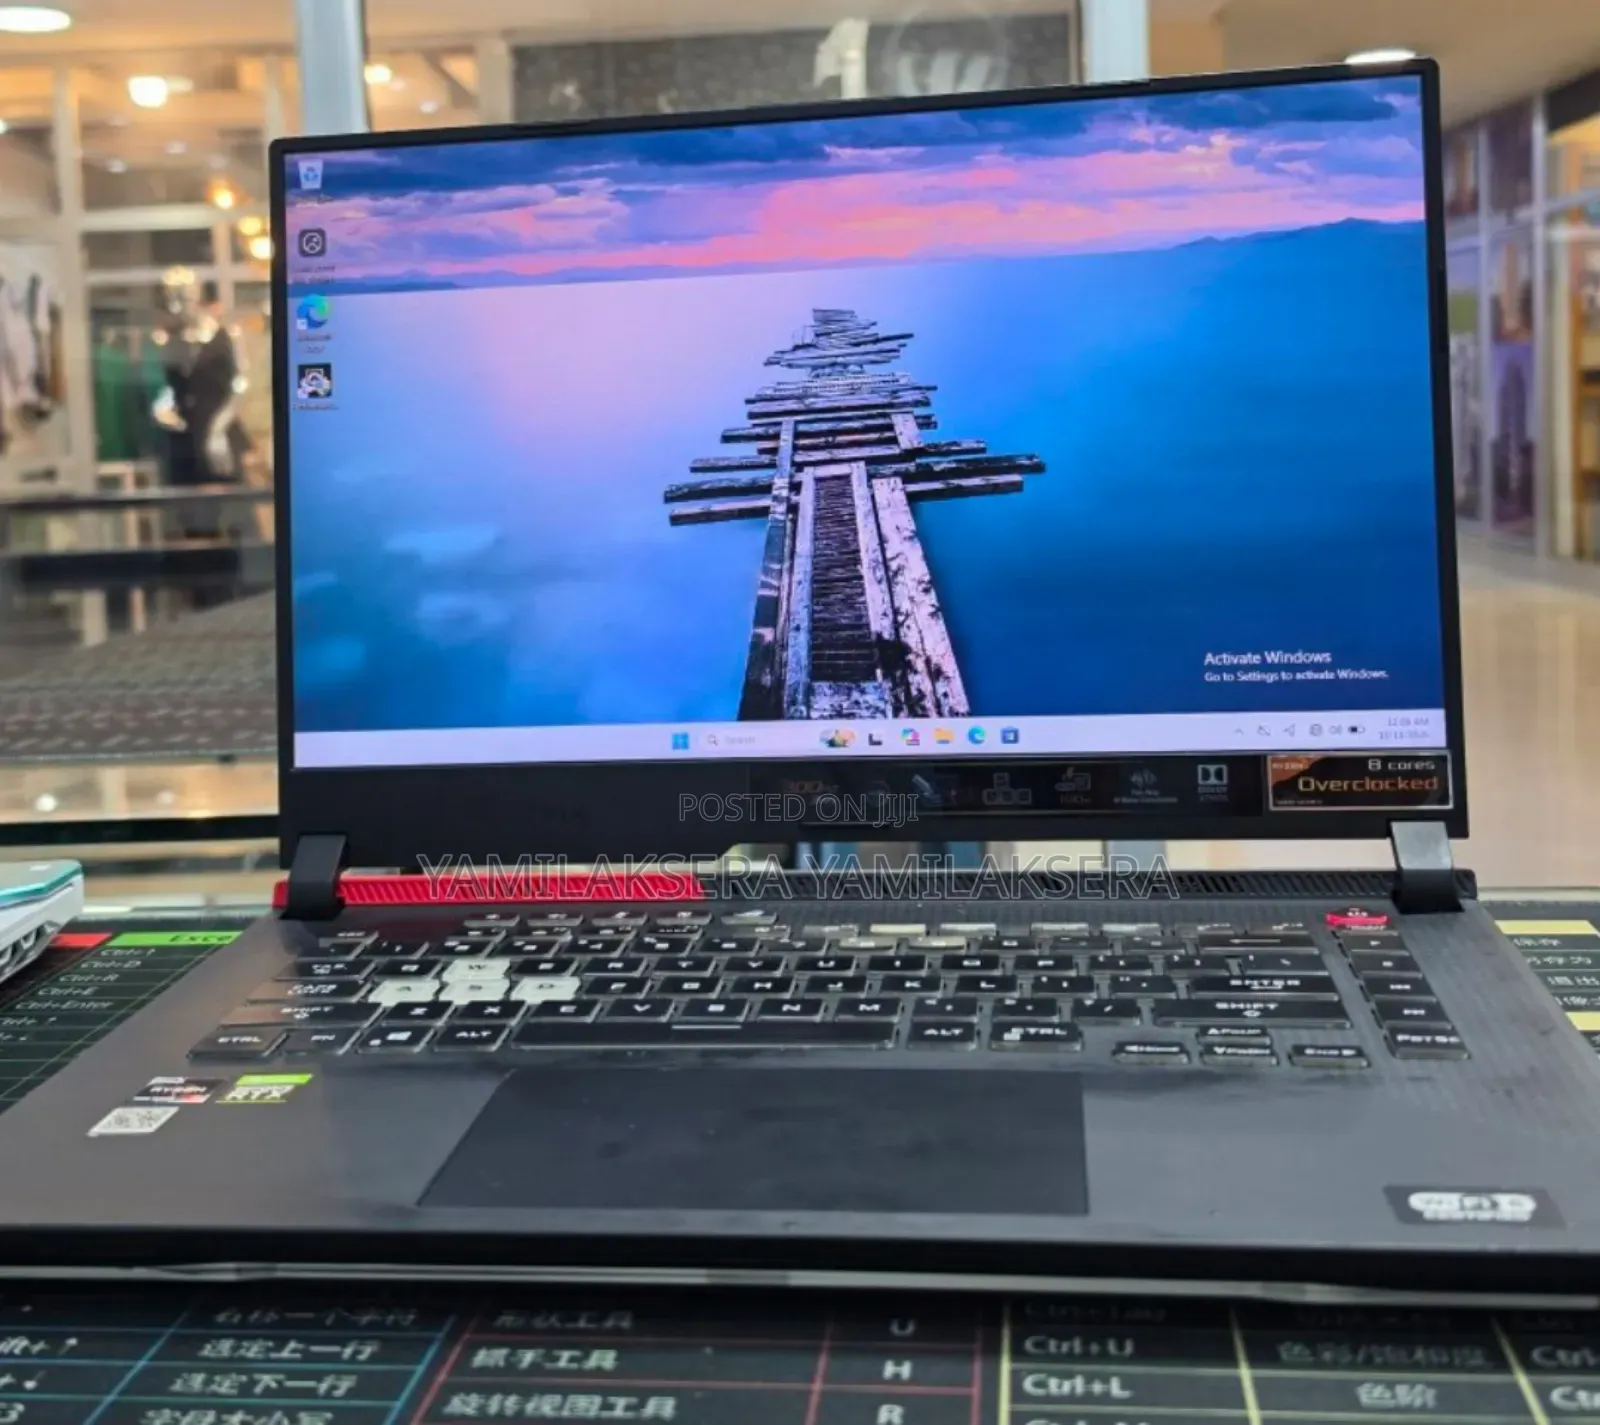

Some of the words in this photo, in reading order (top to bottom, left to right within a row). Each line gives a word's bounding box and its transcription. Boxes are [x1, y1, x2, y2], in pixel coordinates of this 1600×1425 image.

[1204, 651, 1261, 666] Activate
[1264, 649, 1332, 664] Windows
[1204, 671, 1220, 682] Go
[1223, 671, 1234, 681] to
[1237, 669, 1279, 683] Settings
[1281, 670, 1292, 681] to
[1295, 669, 1336, 680] activate
[1337, 668, 1390, 680] Windows.
[1367, 758, 1381, 771] 8
[1387, 760, 1436, 771] cores
[1297, 776, 1439, 792] Overclocked
[168, 935, 233, 943] Exce
[1023, 1334, 1135, 1358] Ctrl+U
[471, 1347, 619, 1371] 抓手工具
[882, 1359, 912, 1382] H
[168, 1372, 358, 1398] 选定下一行
[1021, 1372, 1135, 1400] Ctrl+L
[441, 1391, 679, 1420] 旋转视图工具
[876, 1403, 905, 1425] R
